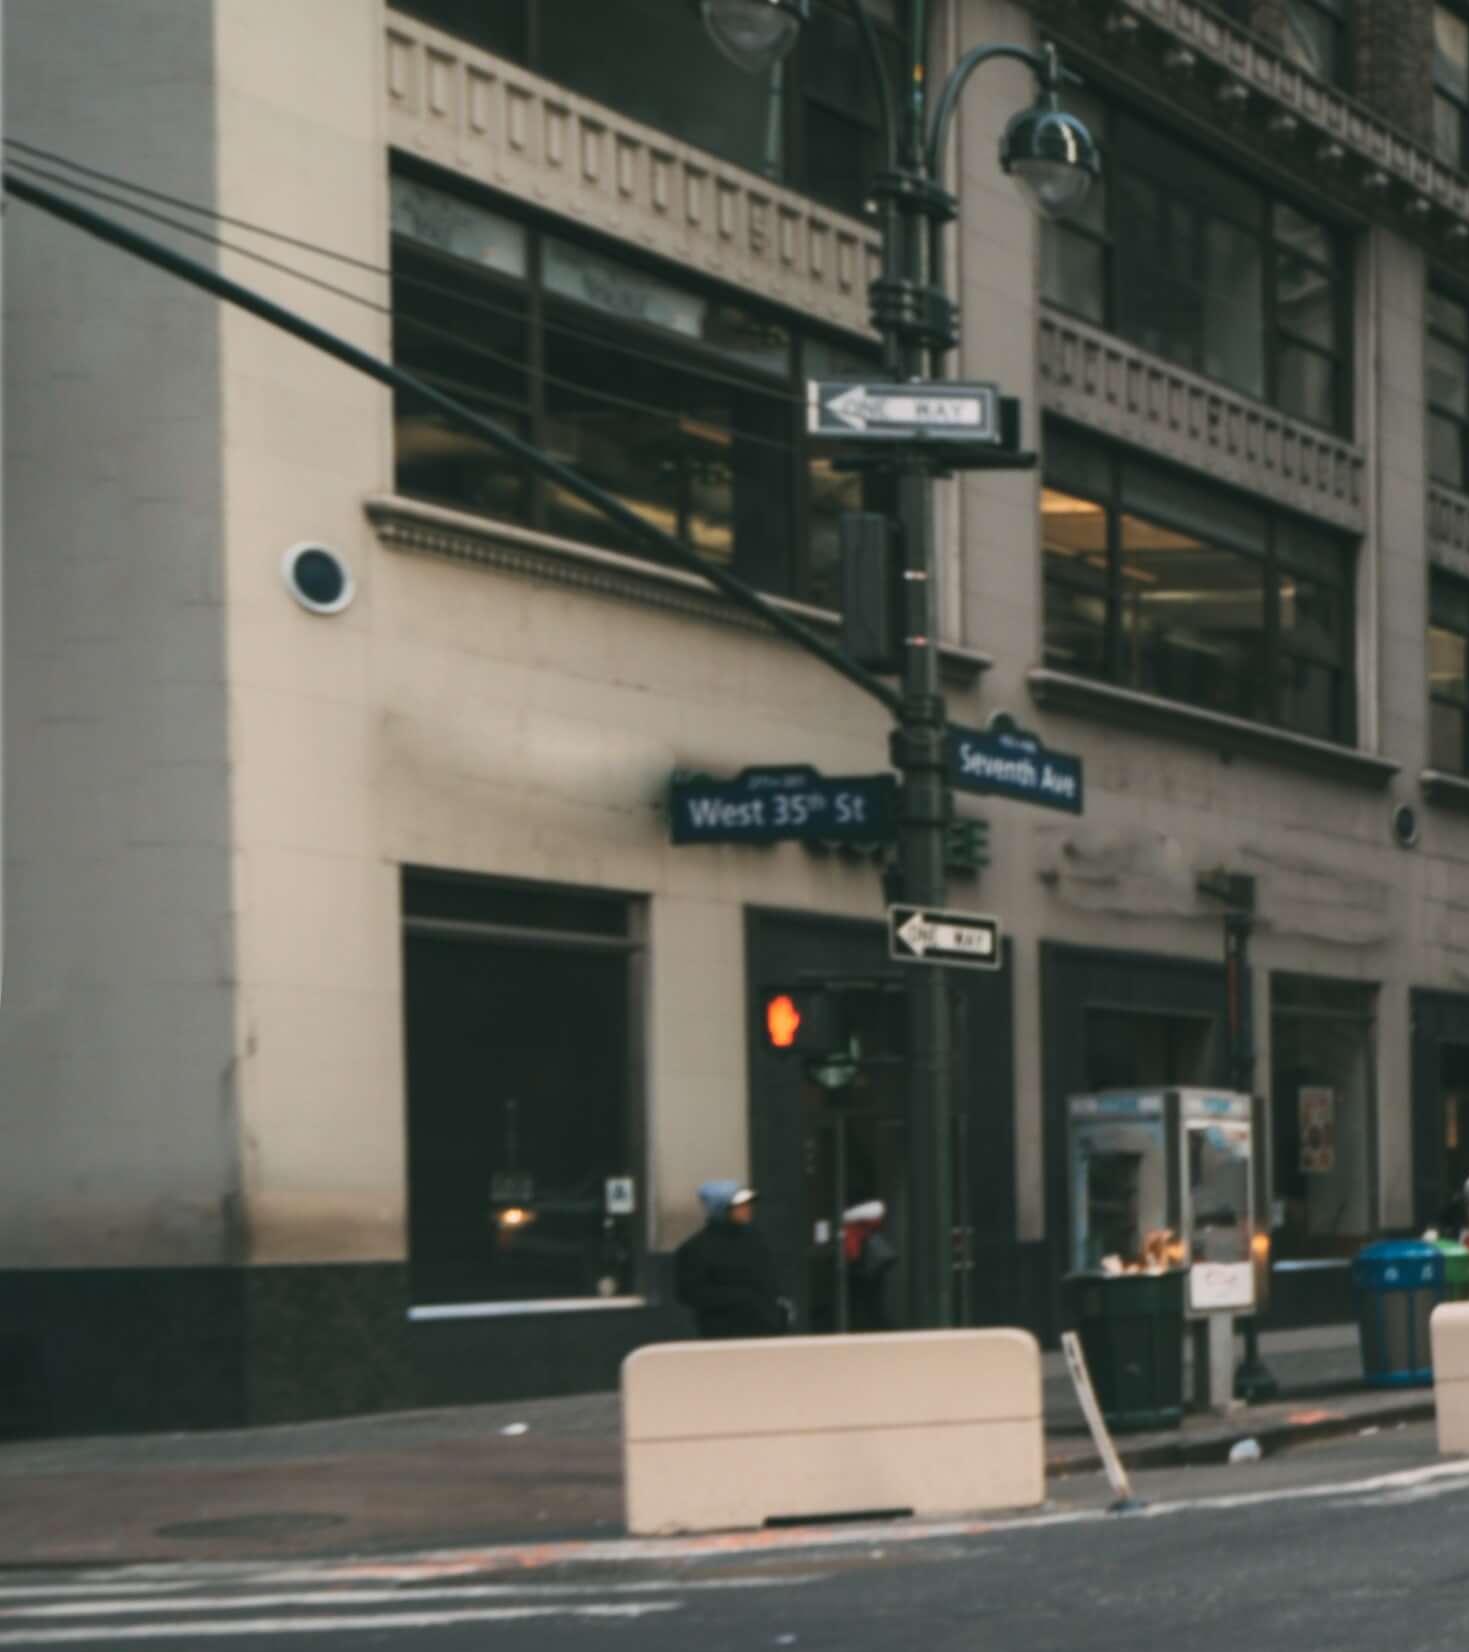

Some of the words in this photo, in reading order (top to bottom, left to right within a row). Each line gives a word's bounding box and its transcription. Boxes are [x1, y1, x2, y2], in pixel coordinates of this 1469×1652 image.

[842, 400, 885, 421] ONE
[914, 400, 963, 420] WAY
[959, 743, 1037, 787] Seventh
[1041, 765, 1075, 798] Ave
[688, 798, 765, 827] West
[773, 793, 827, 825] 35th
[834, 792, 866, 823] St
